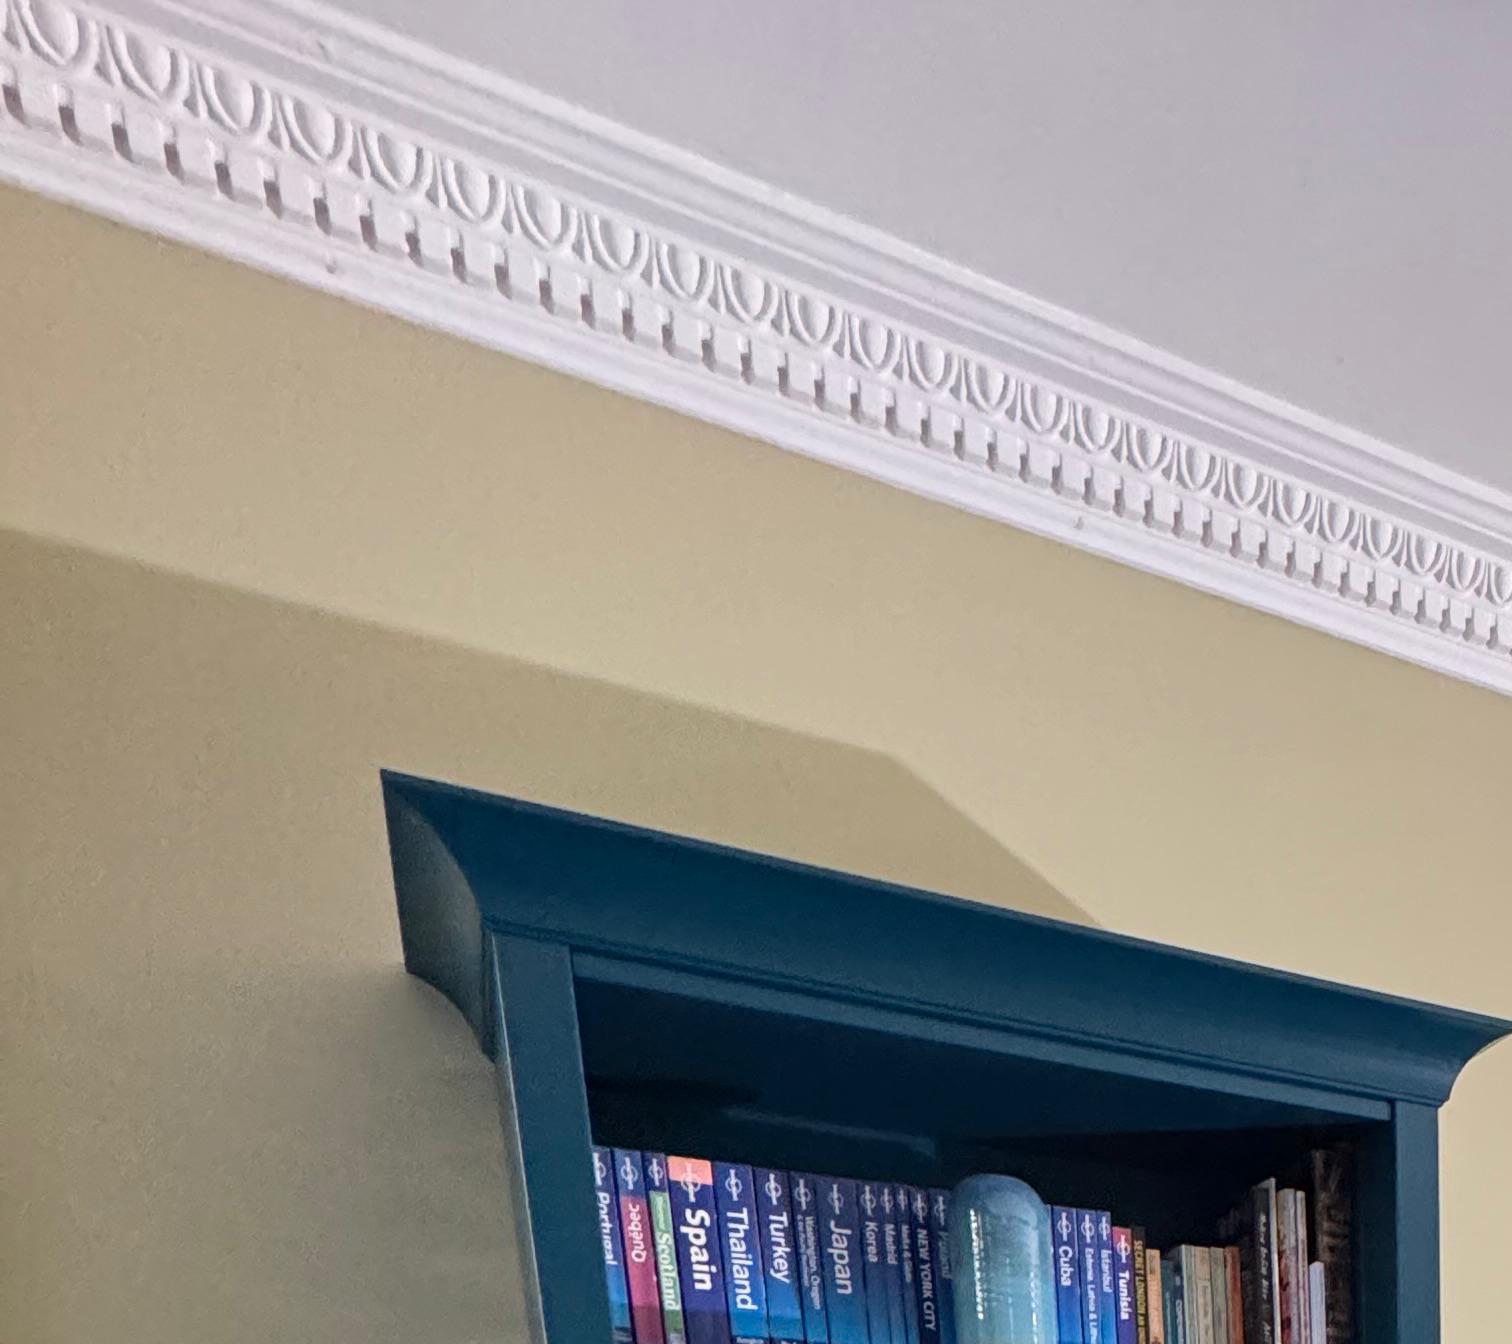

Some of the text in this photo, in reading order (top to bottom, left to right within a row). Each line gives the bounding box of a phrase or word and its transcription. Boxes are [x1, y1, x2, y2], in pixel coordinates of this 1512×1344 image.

[628, 1203, 647, 1263] Québec
[680, 1208, 716, 1290] Spain
[726, 1208, 758, 1310] Thailand
[769, 1211, 791, 1284] Turkey
[827, 1220, 854, 1294] Japan
[865, 1221, 878, 1262] Korea
[884, 1224, 897, 1264] Madrid
[1059, 1246, 1074, 1286] Cuba
[656, 1232, 681, 1310] Scotland
[917, 1229, 936, 1330] NEW YORK CITY
[1119, 1270, 1133, 1320] Tunisia
[1134, 1240, 1146, 1313] SECRET LONDON
